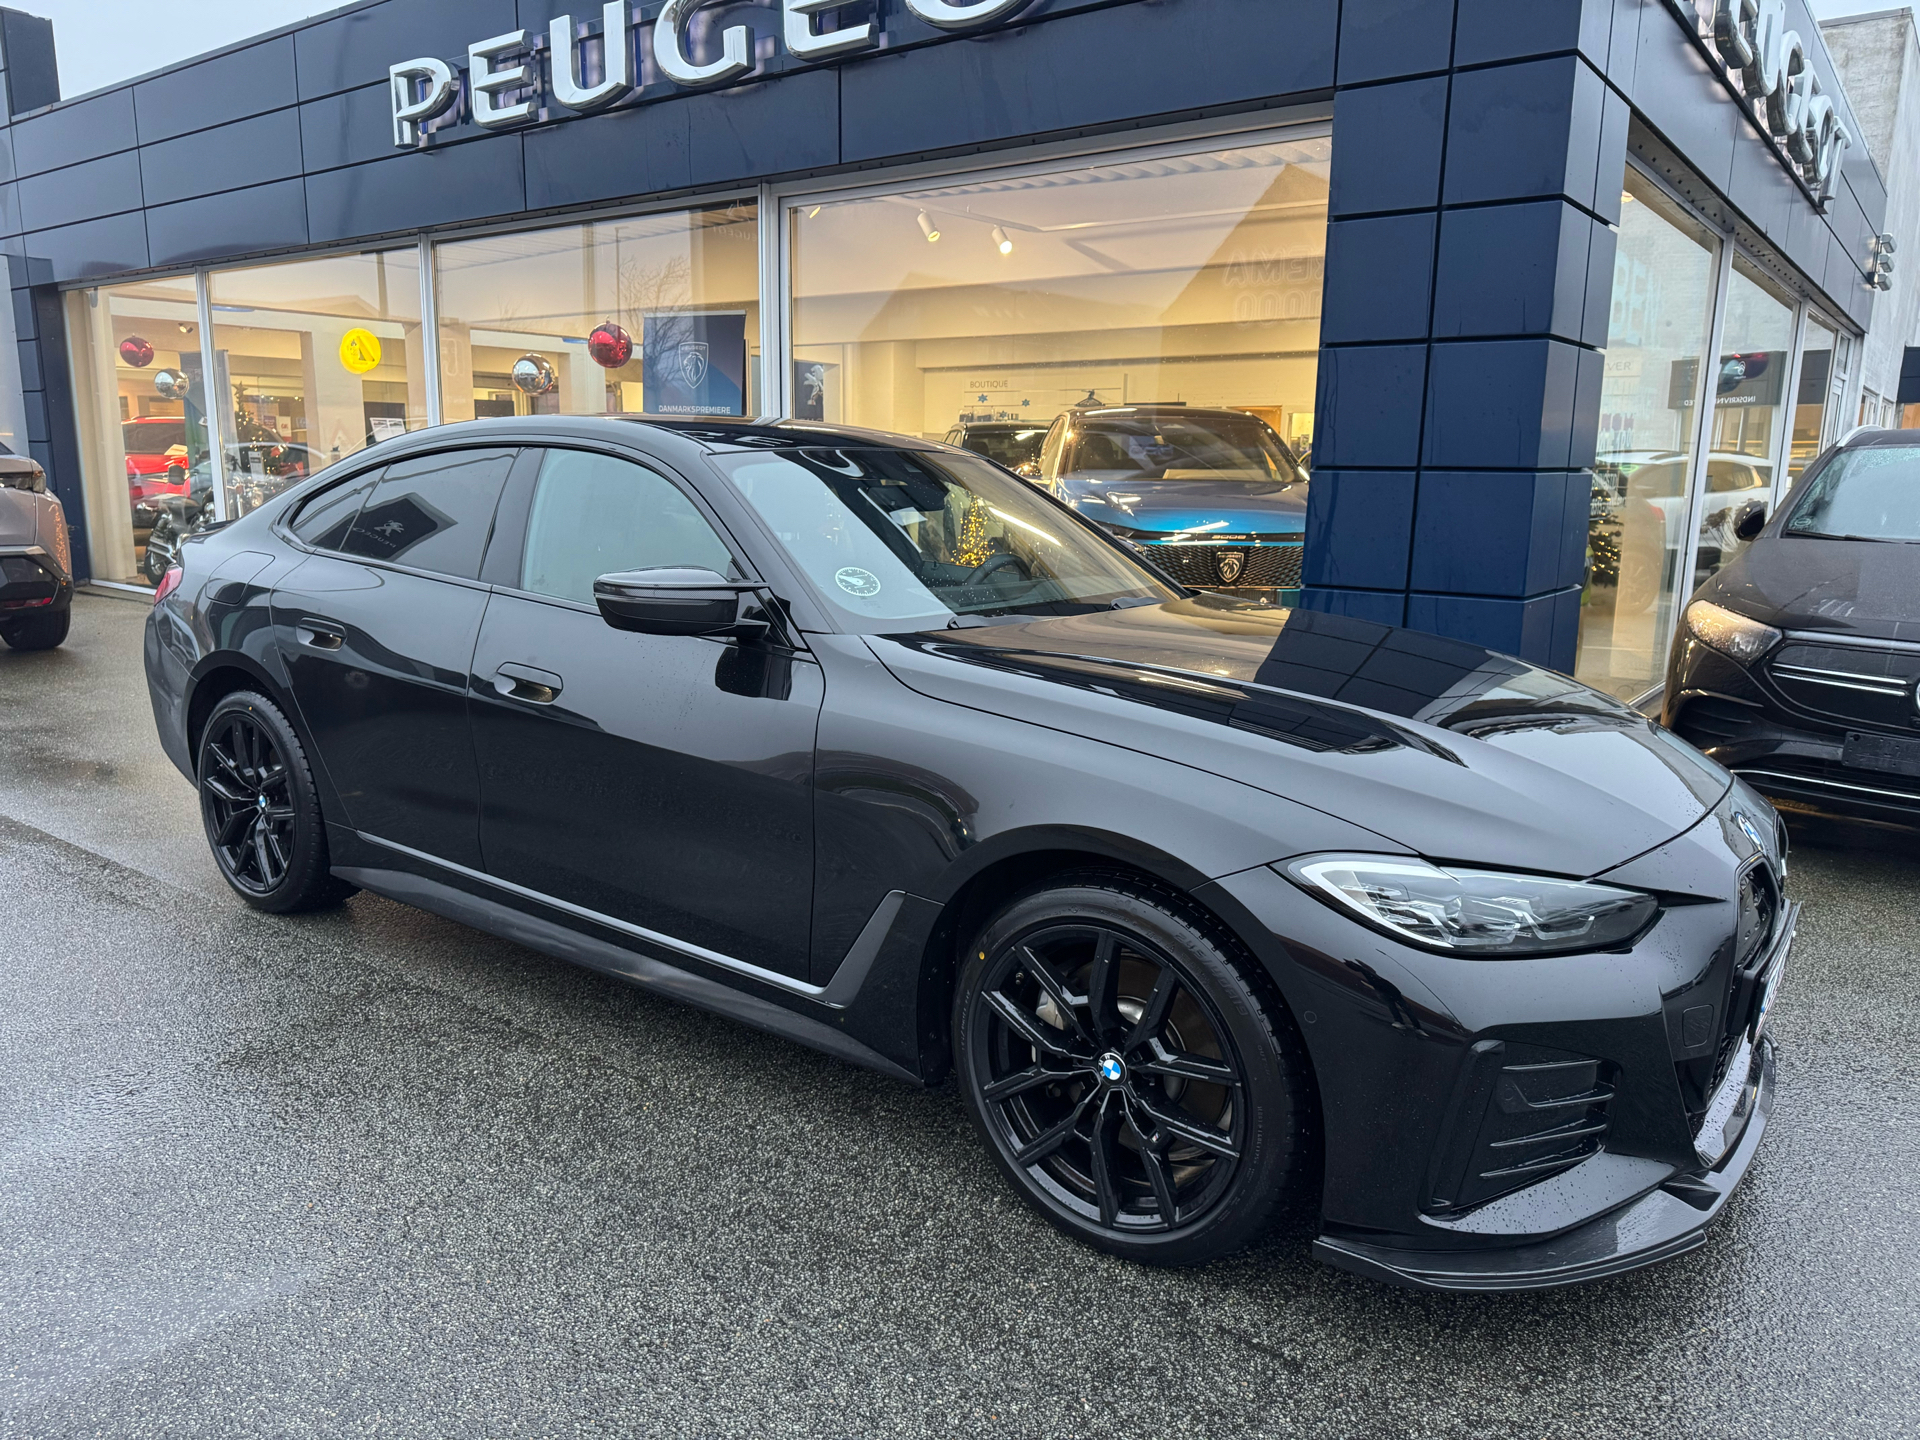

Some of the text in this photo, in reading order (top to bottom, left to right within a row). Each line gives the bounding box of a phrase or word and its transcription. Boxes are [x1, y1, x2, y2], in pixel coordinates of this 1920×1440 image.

[388, 0, 1036, 149] PEUGE
[969, 380, 1009, 389] BOUTIQUE
[658, 404, 731, 415] DANMARKSPREMIERE
